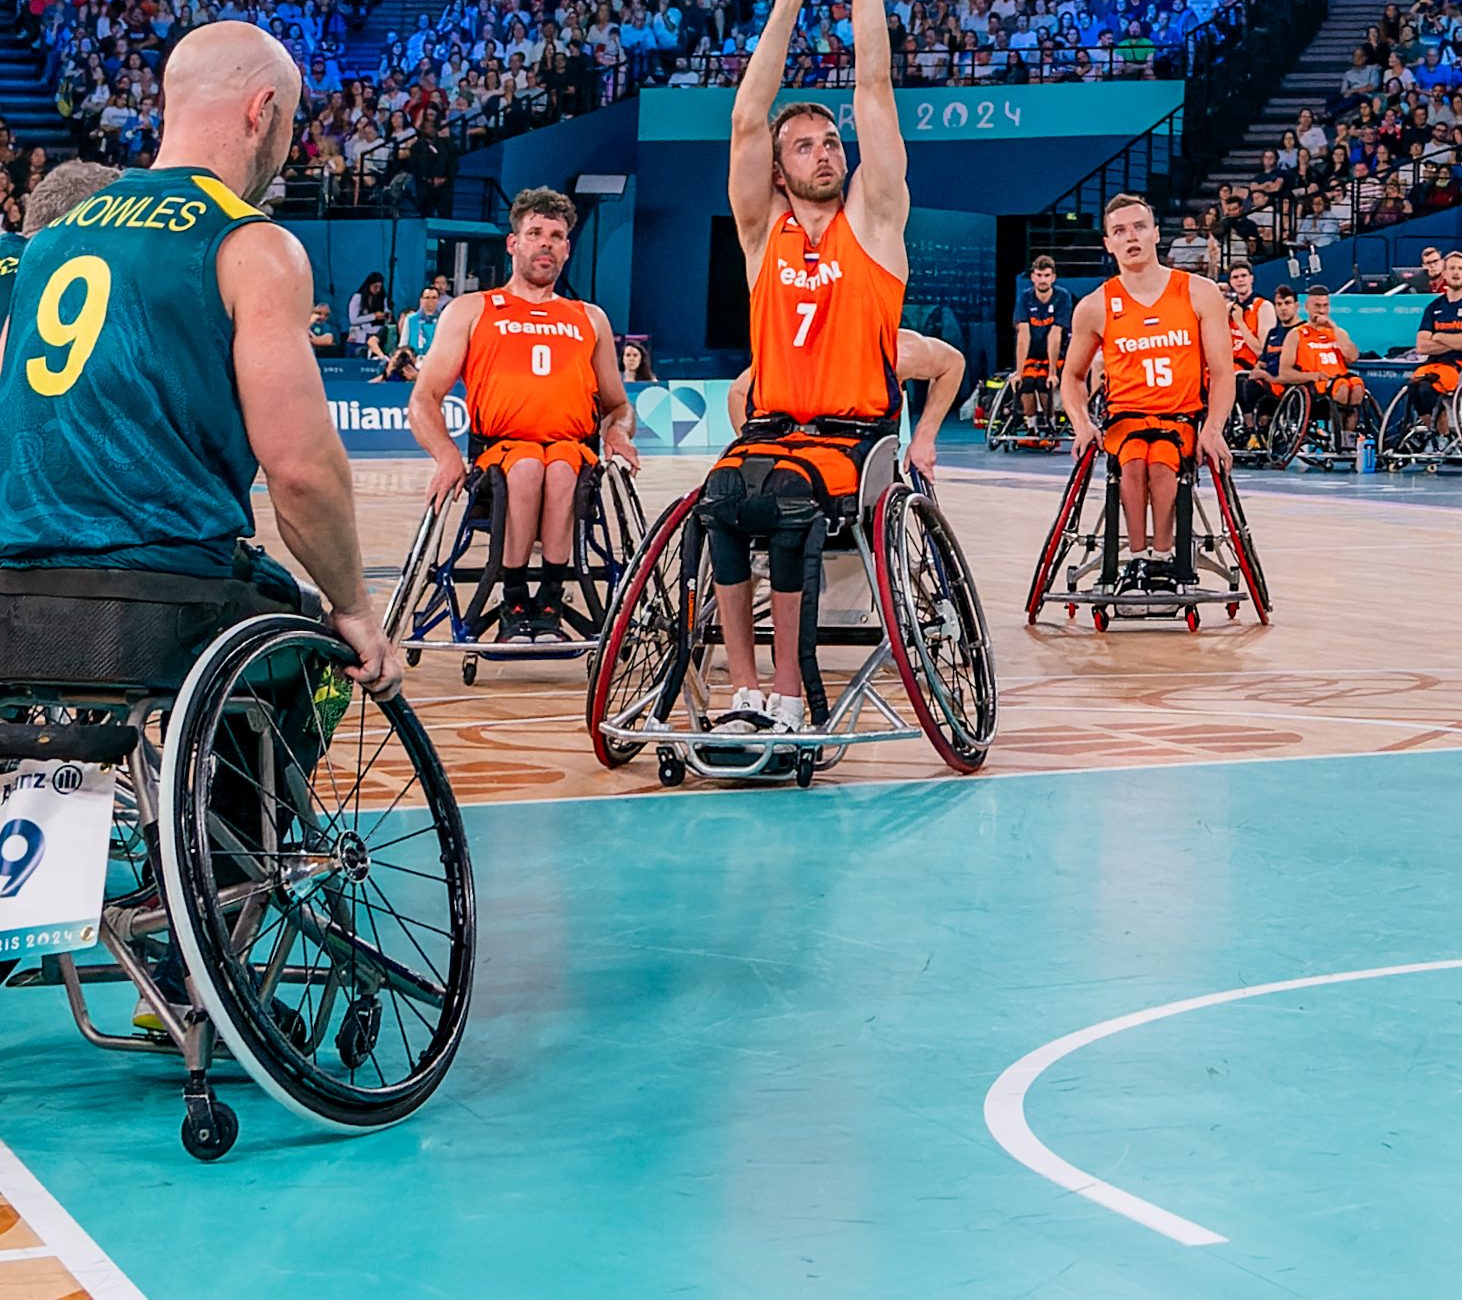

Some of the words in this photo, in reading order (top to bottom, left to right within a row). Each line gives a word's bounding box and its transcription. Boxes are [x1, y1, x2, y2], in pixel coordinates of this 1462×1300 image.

[916, 99, 1021, 130] 2024
[48, 195, 207, 232] NOWLES
[26, 255, 111, 397] 9
[494, 318, 584, 342] TeamNL
[793, 302, 818, 347] 7
[1114, 328, 1192, 354] TeamNL
[530, 344, 552, 377] 0
[1141, 356, 1173, 388] 15
[327, 400, 412, 431] llian
[26, 929, 73, 949] 2024
